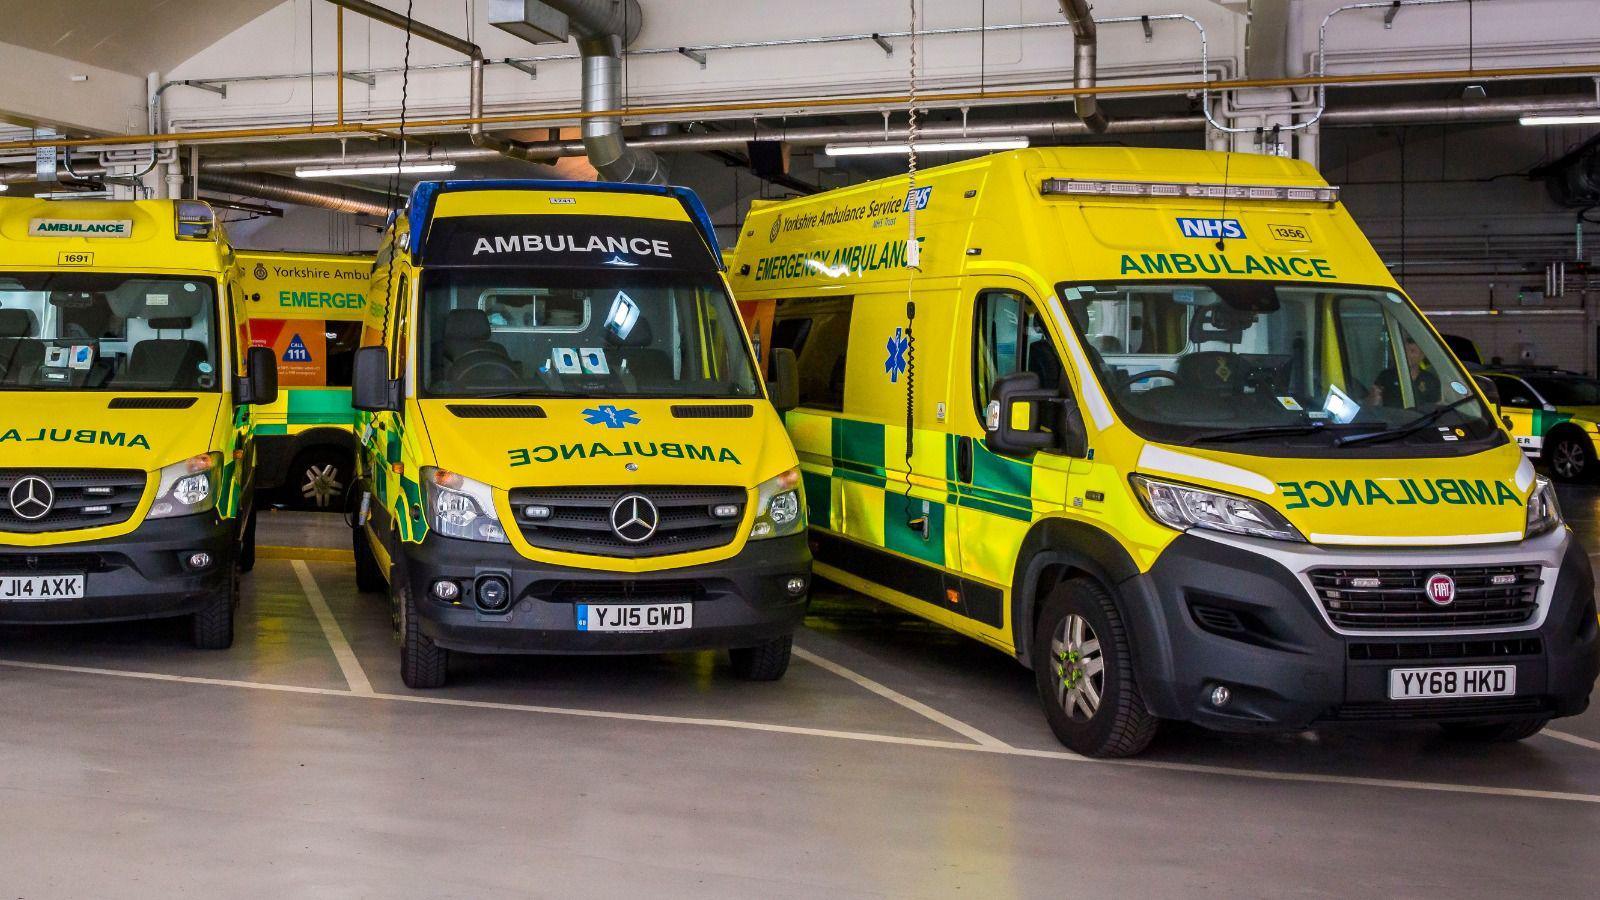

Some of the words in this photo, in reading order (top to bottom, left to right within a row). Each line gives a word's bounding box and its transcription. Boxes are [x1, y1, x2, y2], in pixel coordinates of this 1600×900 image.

[783, 213, 818, 232] Yorkshire
[817, 205, 866, 226] Ambulance
[867, 196, 902, 218] Service
[37, 223, 124, 233] AMBULANCE
[1182, 219, 1241, 238] NHS
[1276, 228, 1304, 239] 1356
[473, 235, 672, 258] AMBULANCE
[64, 254, 88, 263] 1691
[755, 250, 830, 281] EMERGENCY
[1121, 254, 1337, 279] AMBULANCE
[273, 266, 330, 278] Yorkshire
[288, 349, 306, 360] 111
[41, 579, 76, 595] AXK
[1433, 582, 1450, 597] FIAT
[596, 607, 641, 626] YJ15
[647, 606, 685, 626] GWD
[1401, 671, 1458, 695] YY68
[1464, 670, 1506, 693] HKD
